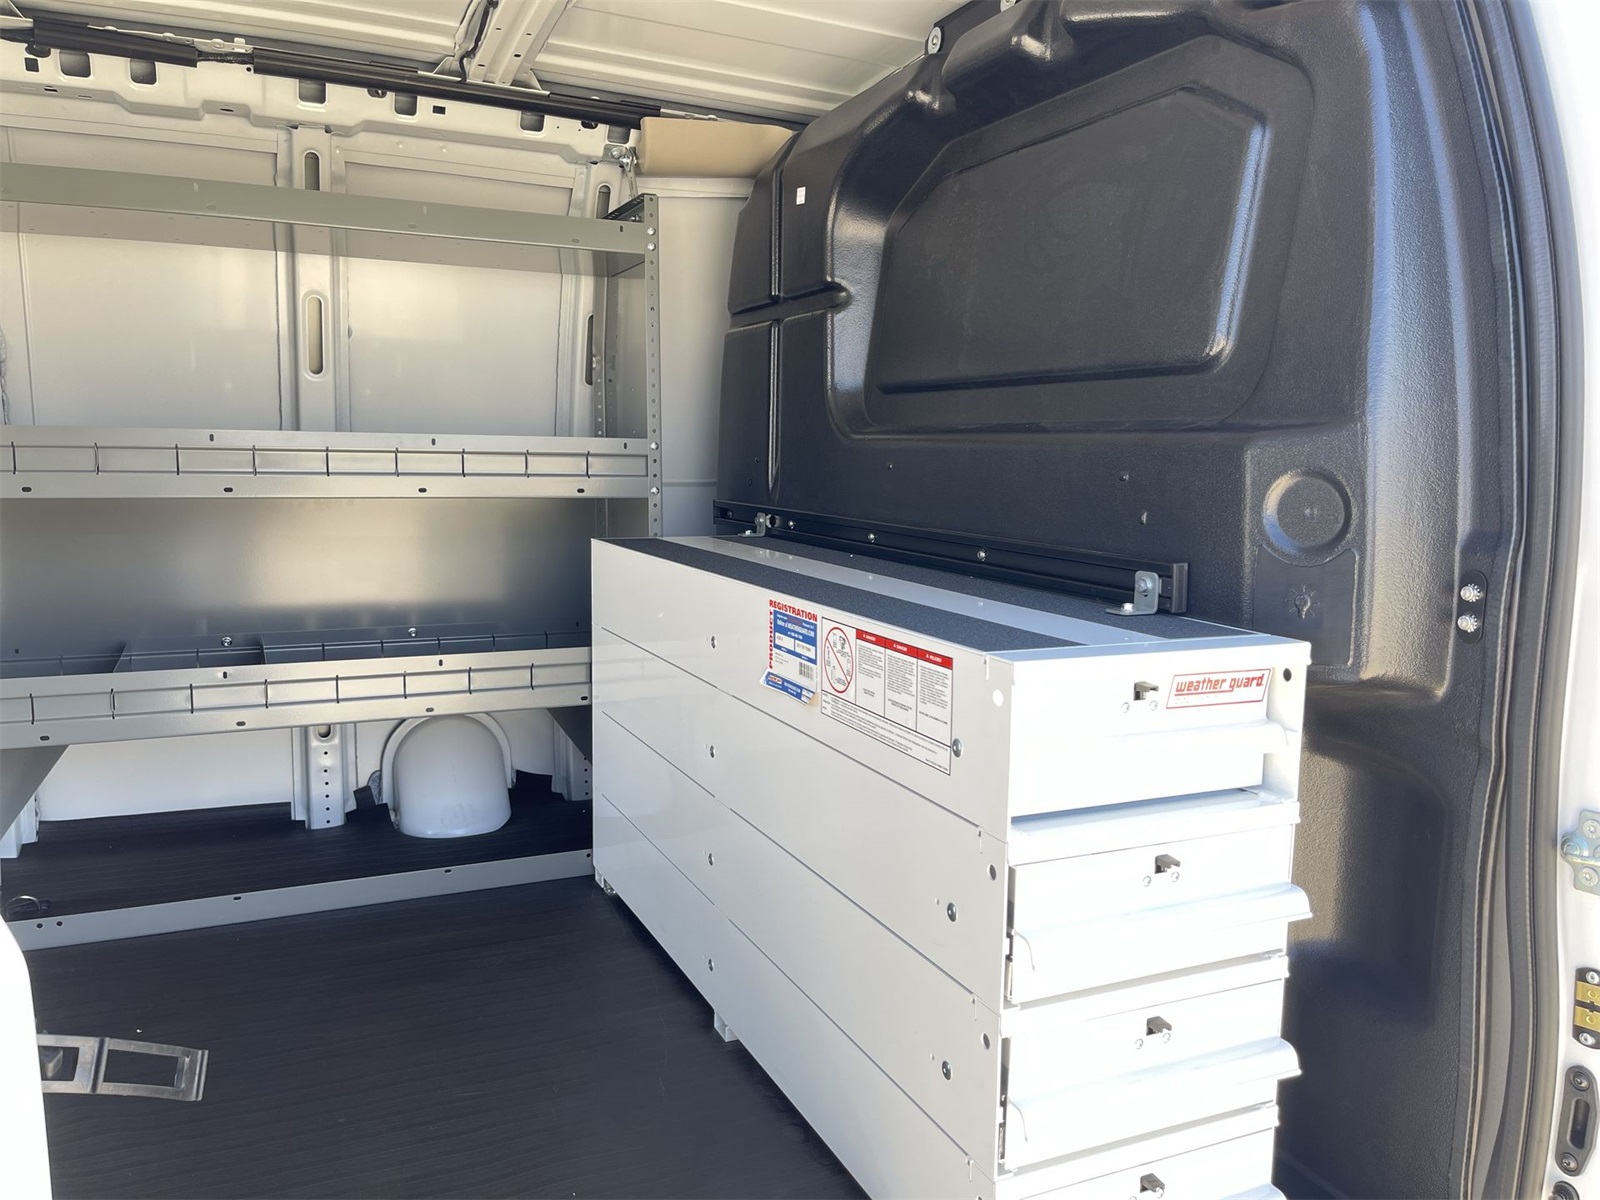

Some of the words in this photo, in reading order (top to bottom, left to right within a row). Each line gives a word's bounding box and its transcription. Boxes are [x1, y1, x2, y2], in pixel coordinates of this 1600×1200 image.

[769, 599, 818, 622] REGISTRATION
[1175, 677, 1227, 692] weather
[1229, 674, 1265, 692] guard
